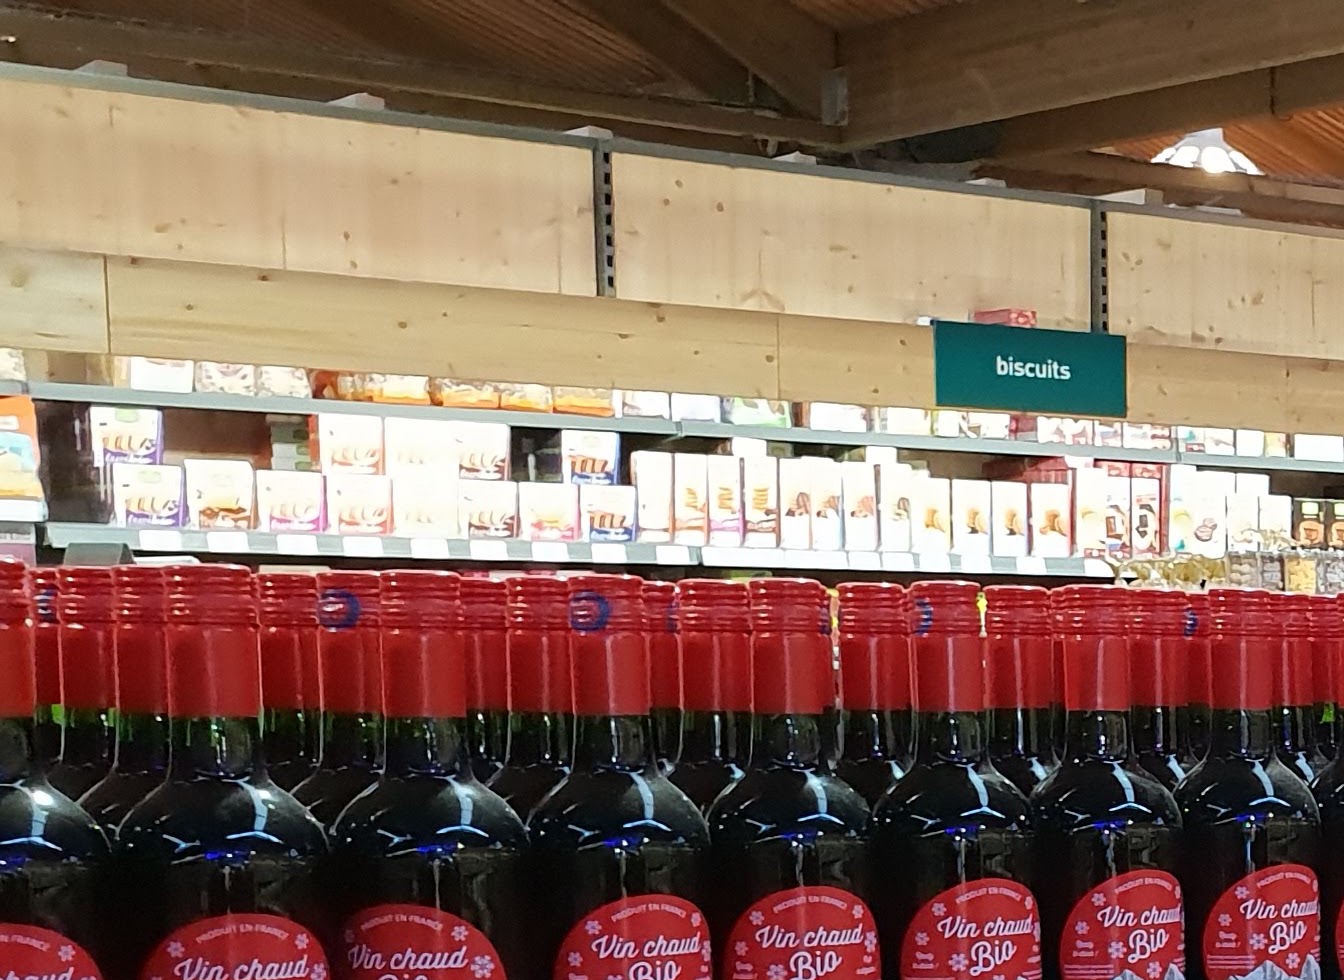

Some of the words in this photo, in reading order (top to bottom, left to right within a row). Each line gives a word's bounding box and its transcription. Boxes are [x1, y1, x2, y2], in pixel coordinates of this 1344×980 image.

[995, 355, 1072, 383] biscuits
[1097, 905, 1137, 928] Vin
[1239, 899, 1278, 921] Vin
[196, 925, 237, 944] PRODUIT
[755, 925, 798, 950] Vin
[801, 923, 864, 947] chaud
[936, 915, 980, 940] Vin
[982, 916, 1034, 938] chaud
[1268, 920, 1307, 954] Bio
[348, 945, 386, 970] Vin
[389, 946, 469, 970] chaud
[591, 933, 638, 962] Vin
[643, 933, 703, 959] chaud
[968, 939, 1018, 978] Bio
[1128, 928, 1169, 964] Bio
